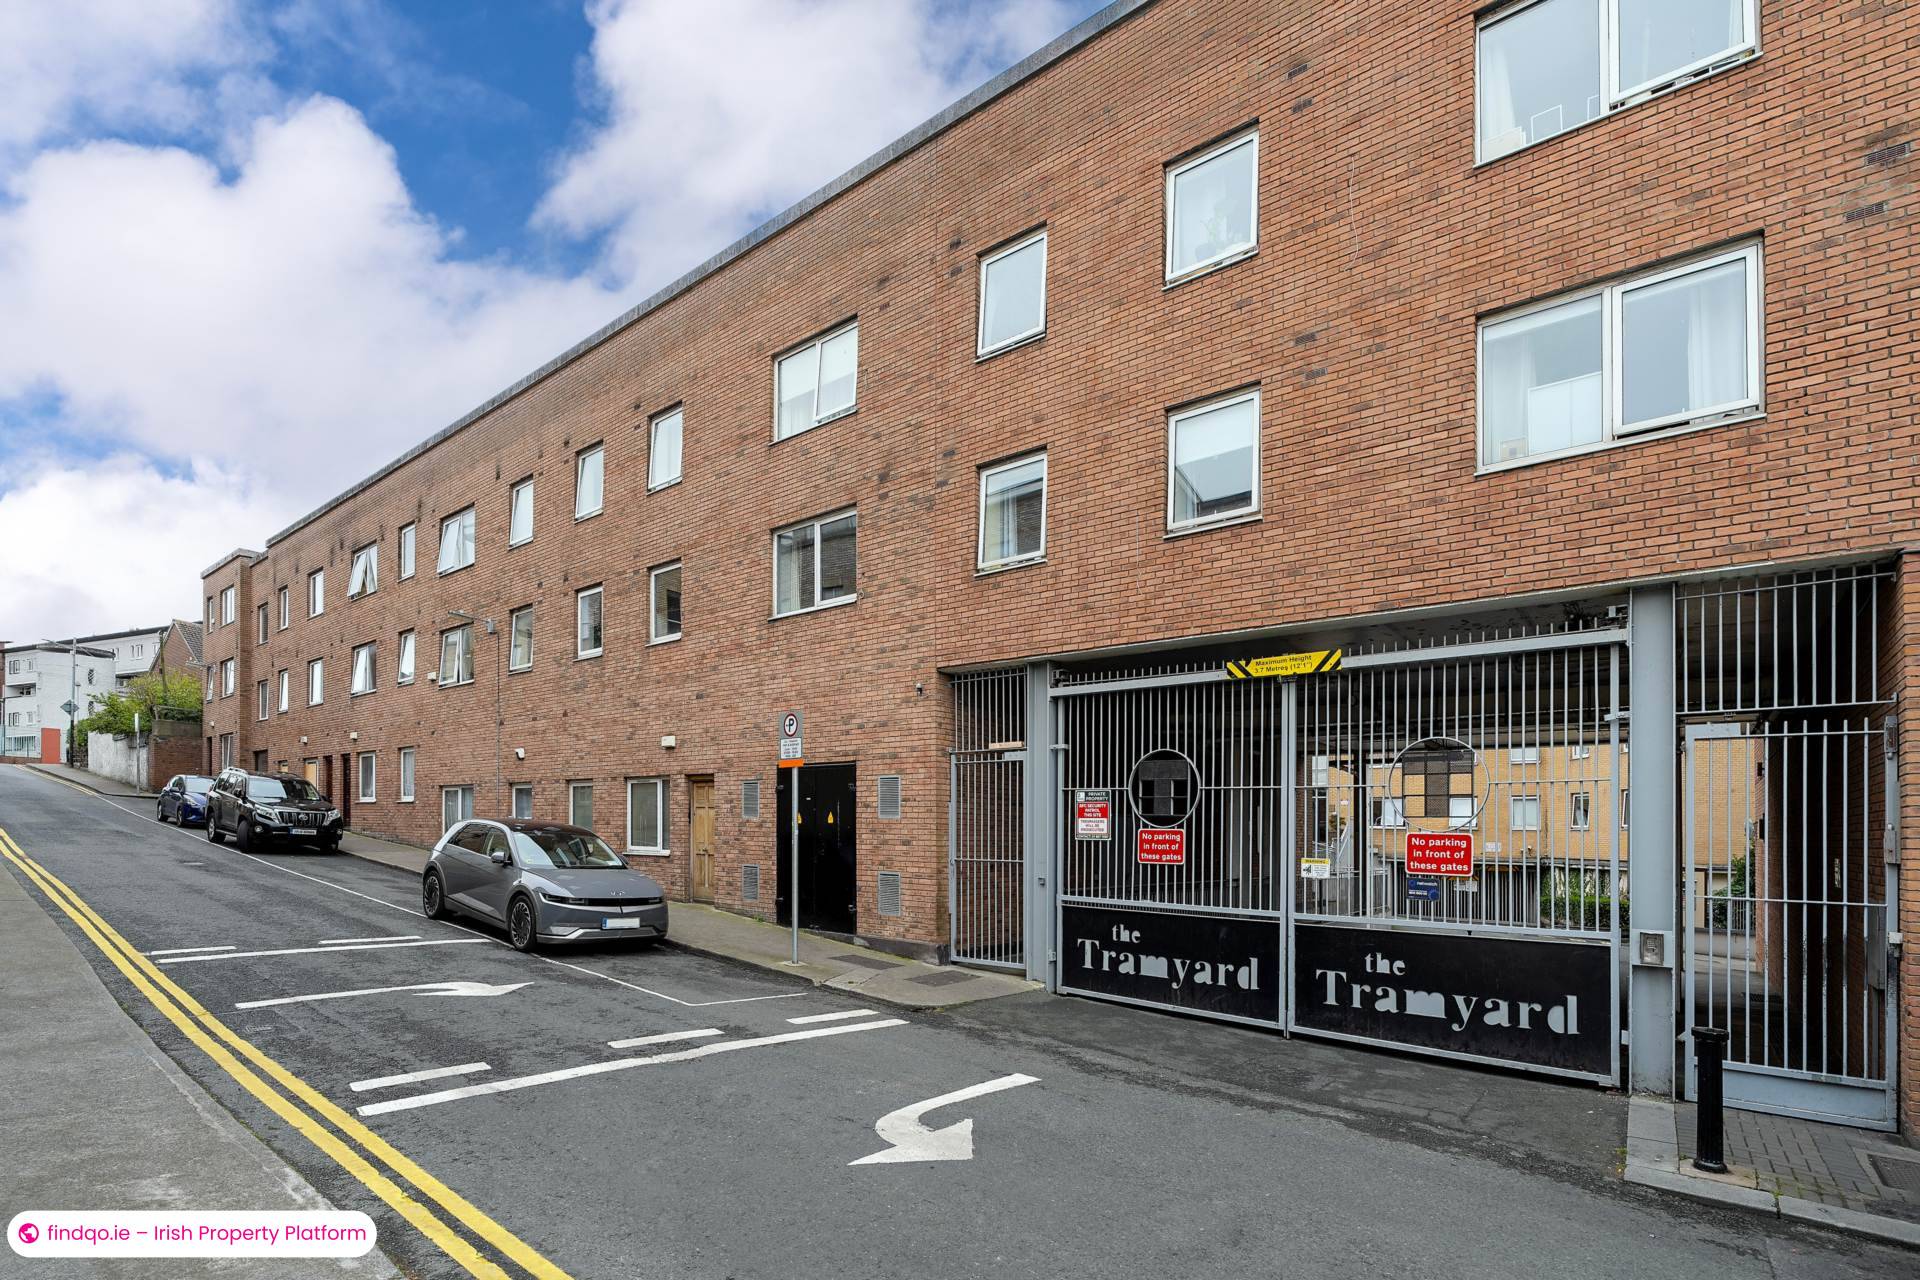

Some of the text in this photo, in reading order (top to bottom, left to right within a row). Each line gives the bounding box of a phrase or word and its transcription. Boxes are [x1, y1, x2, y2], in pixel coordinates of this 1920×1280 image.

[1255, 658, 1288, 666] Maximum
[1142, 832, 1181, 842] No parking
[1411, 837, 1467, 849] No parking
[1141, 852, 1182, 861] these gates
[1413, 849, 1465, 859] in front of
[1409, 861, 1469, 872] these gates
[1111, 923, 1141, 944] the
[1077, 938, 1260, 990] Tramyard
[1364, 952, 1406, 976] the
[1315, 968, 1581, 1035] Tramyard
